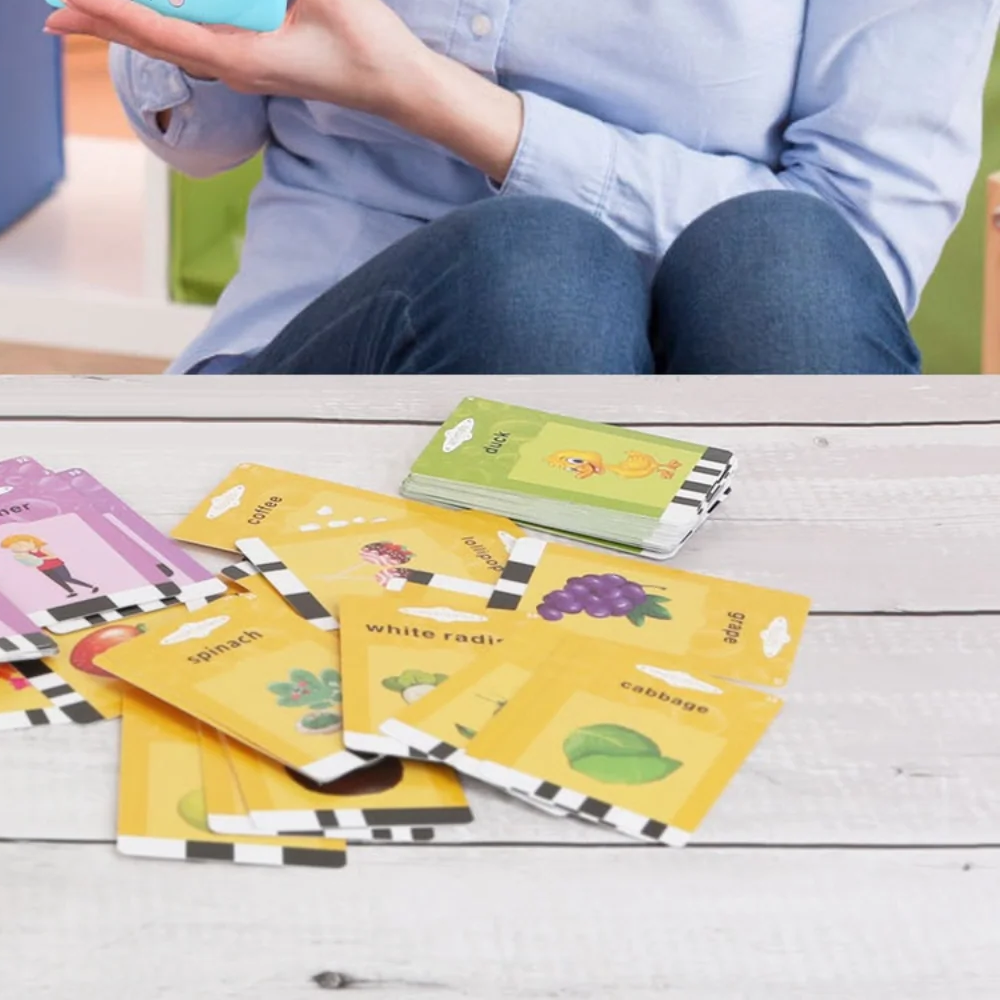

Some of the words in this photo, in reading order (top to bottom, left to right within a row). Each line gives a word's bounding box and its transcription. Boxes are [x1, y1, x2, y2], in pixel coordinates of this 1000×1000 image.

[483, 430, 511, 454] duck
[247, 496, 283, 525] coffee
[365, 624, 435, 639] white
[721, 611, 746, 644] grape
[187, 629, 264, 665] spinach
[620, 680, 709, 714] cabbage
